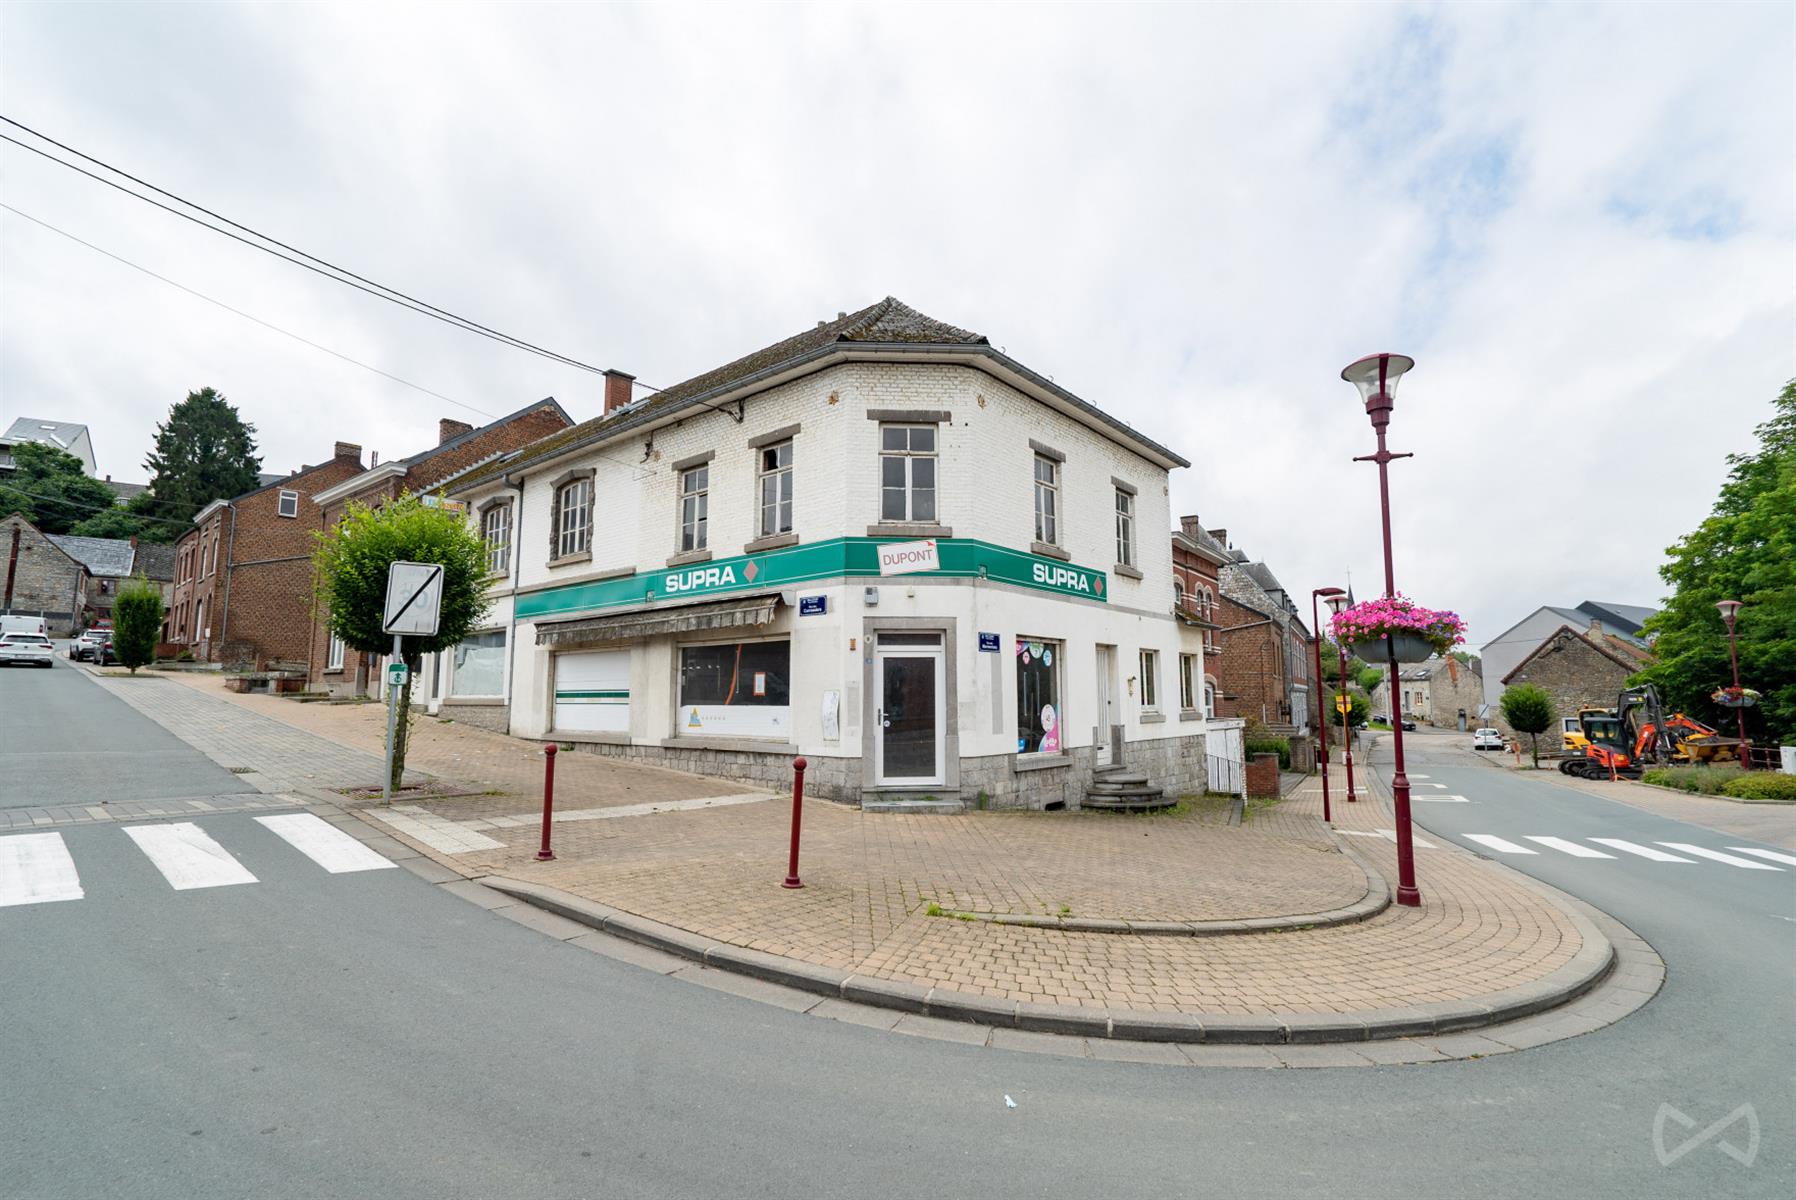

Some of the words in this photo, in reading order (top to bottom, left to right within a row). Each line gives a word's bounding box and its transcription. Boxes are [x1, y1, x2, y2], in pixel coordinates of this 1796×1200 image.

[882, 549, 933, 566] DUPONT
[665, 566, 736, 592] SUPRA
[1032, 563, 1090, 592] SUPRA
